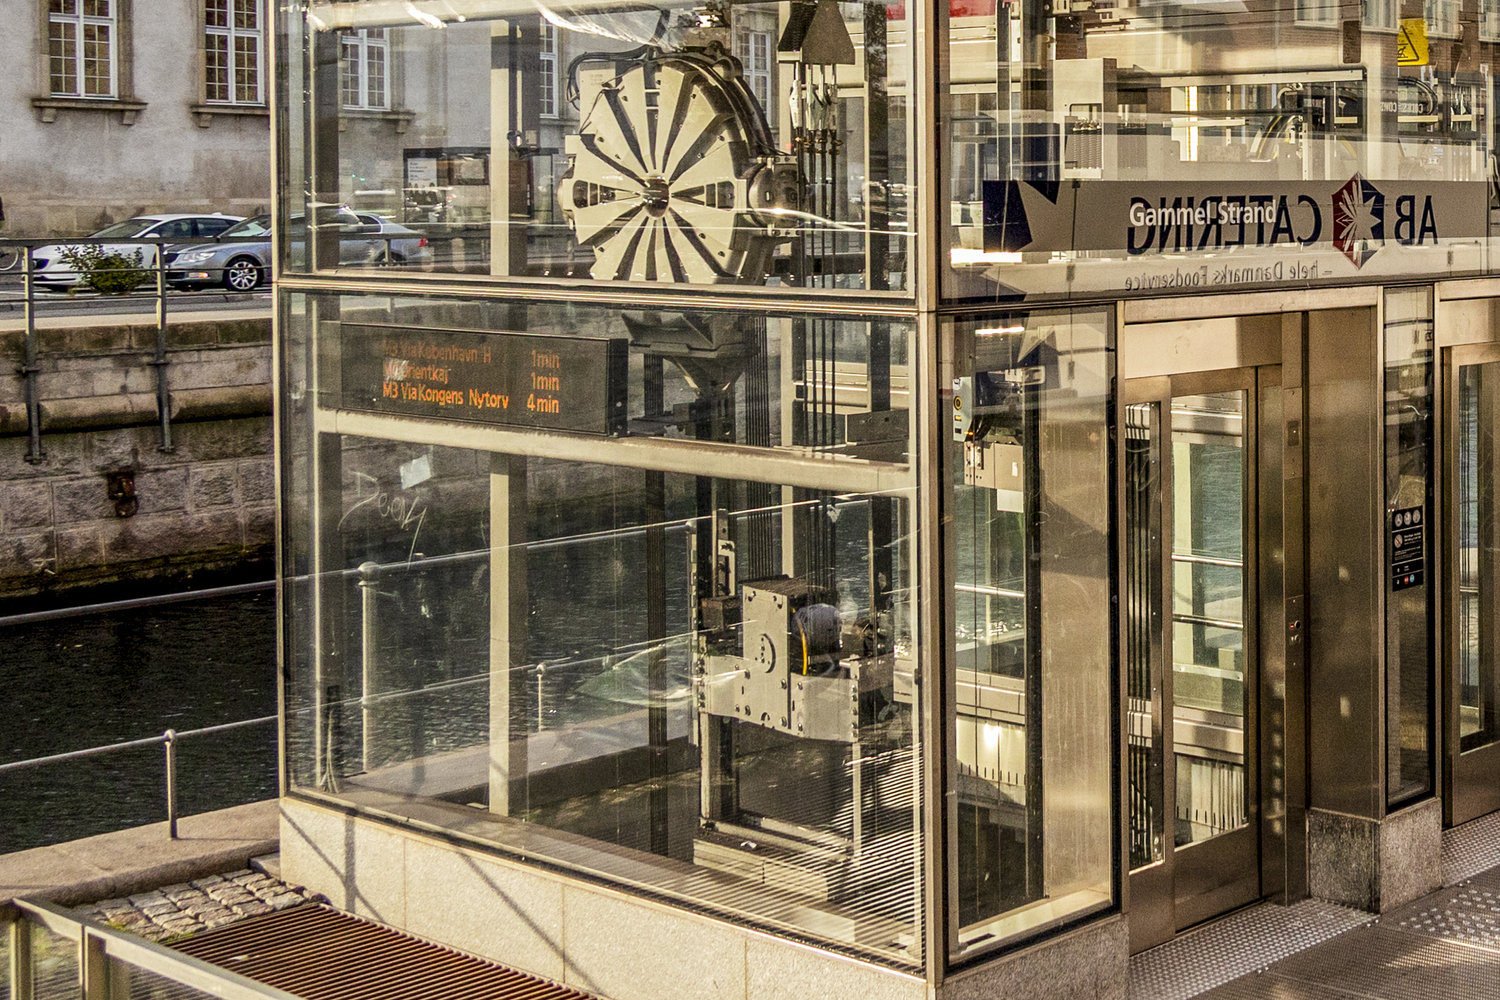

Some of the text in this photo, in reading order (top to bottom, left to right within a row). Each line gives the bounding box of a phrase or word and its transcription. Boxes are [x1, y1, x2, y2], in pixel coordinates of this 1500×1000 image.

[1129, 199, 1277, 226] Gammel Strand
[382, 381, 399, 399] M3
[418, 384, 464, 406] Kongens
[469, 388, 509, 409] Nytorv
